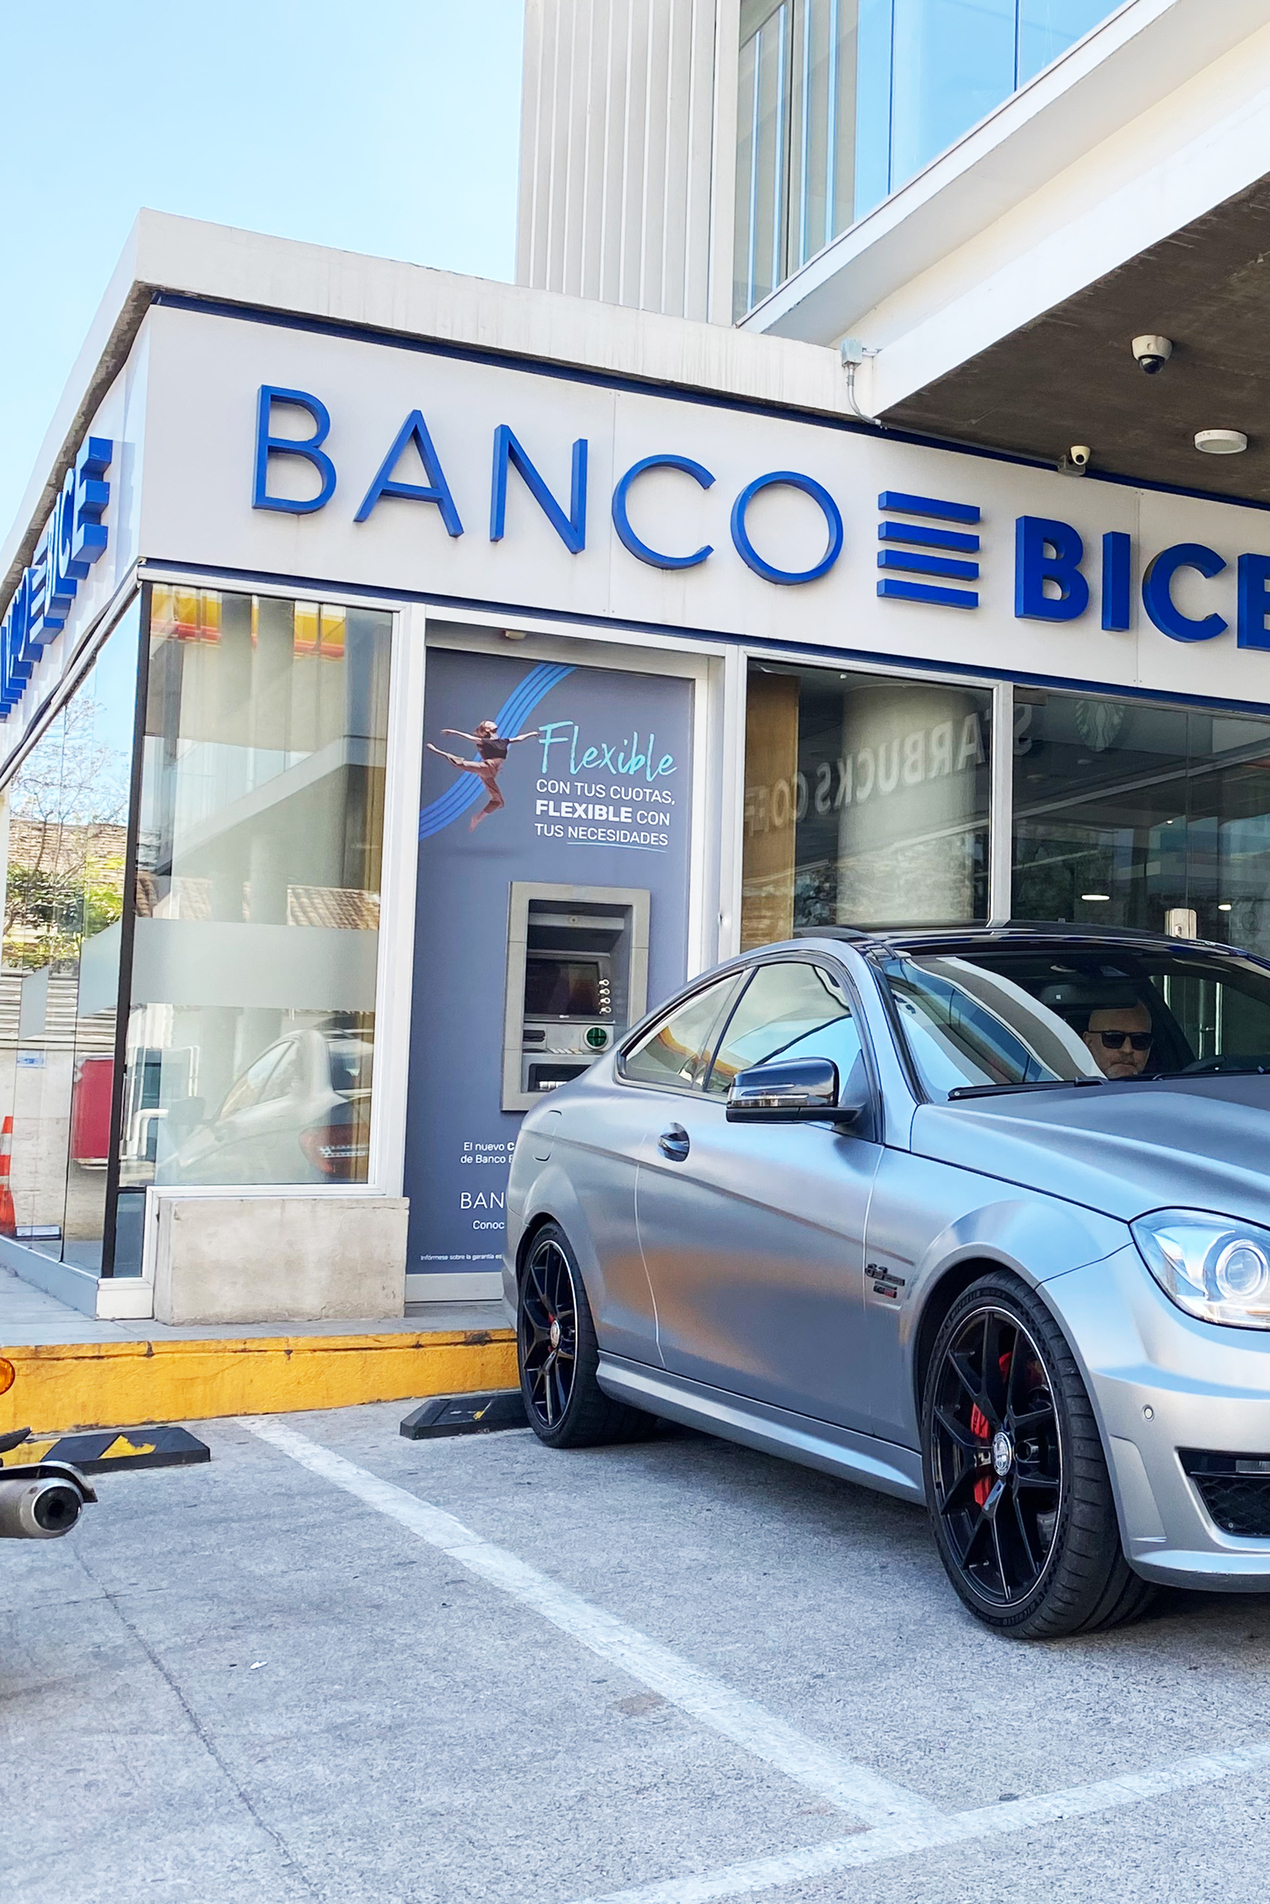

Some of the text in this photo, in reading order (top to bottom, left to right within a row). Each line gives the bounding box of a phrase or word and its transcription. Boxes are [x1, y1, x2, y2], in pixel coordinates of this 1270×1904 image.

[251, 384, 843, 586] BANCO
[538, 720, 678, 782] Flexible
[536, 779, 676, 806] CON TUS CUOTAS,
[535, 799, 671, 826] FLEXIBLE CON
[534, 823, 669, 846] TUS NECESIDADES
[463, 1142, 473, 1151] El
[475, 1142, 505, 1151] nuevo
[460, 1154, 473, 1164] de
[475, 1154, 506, 1164] Banco
[460, 1191, 505, 1209] BAN
[472, 1220, 505, 1230] Conoc
